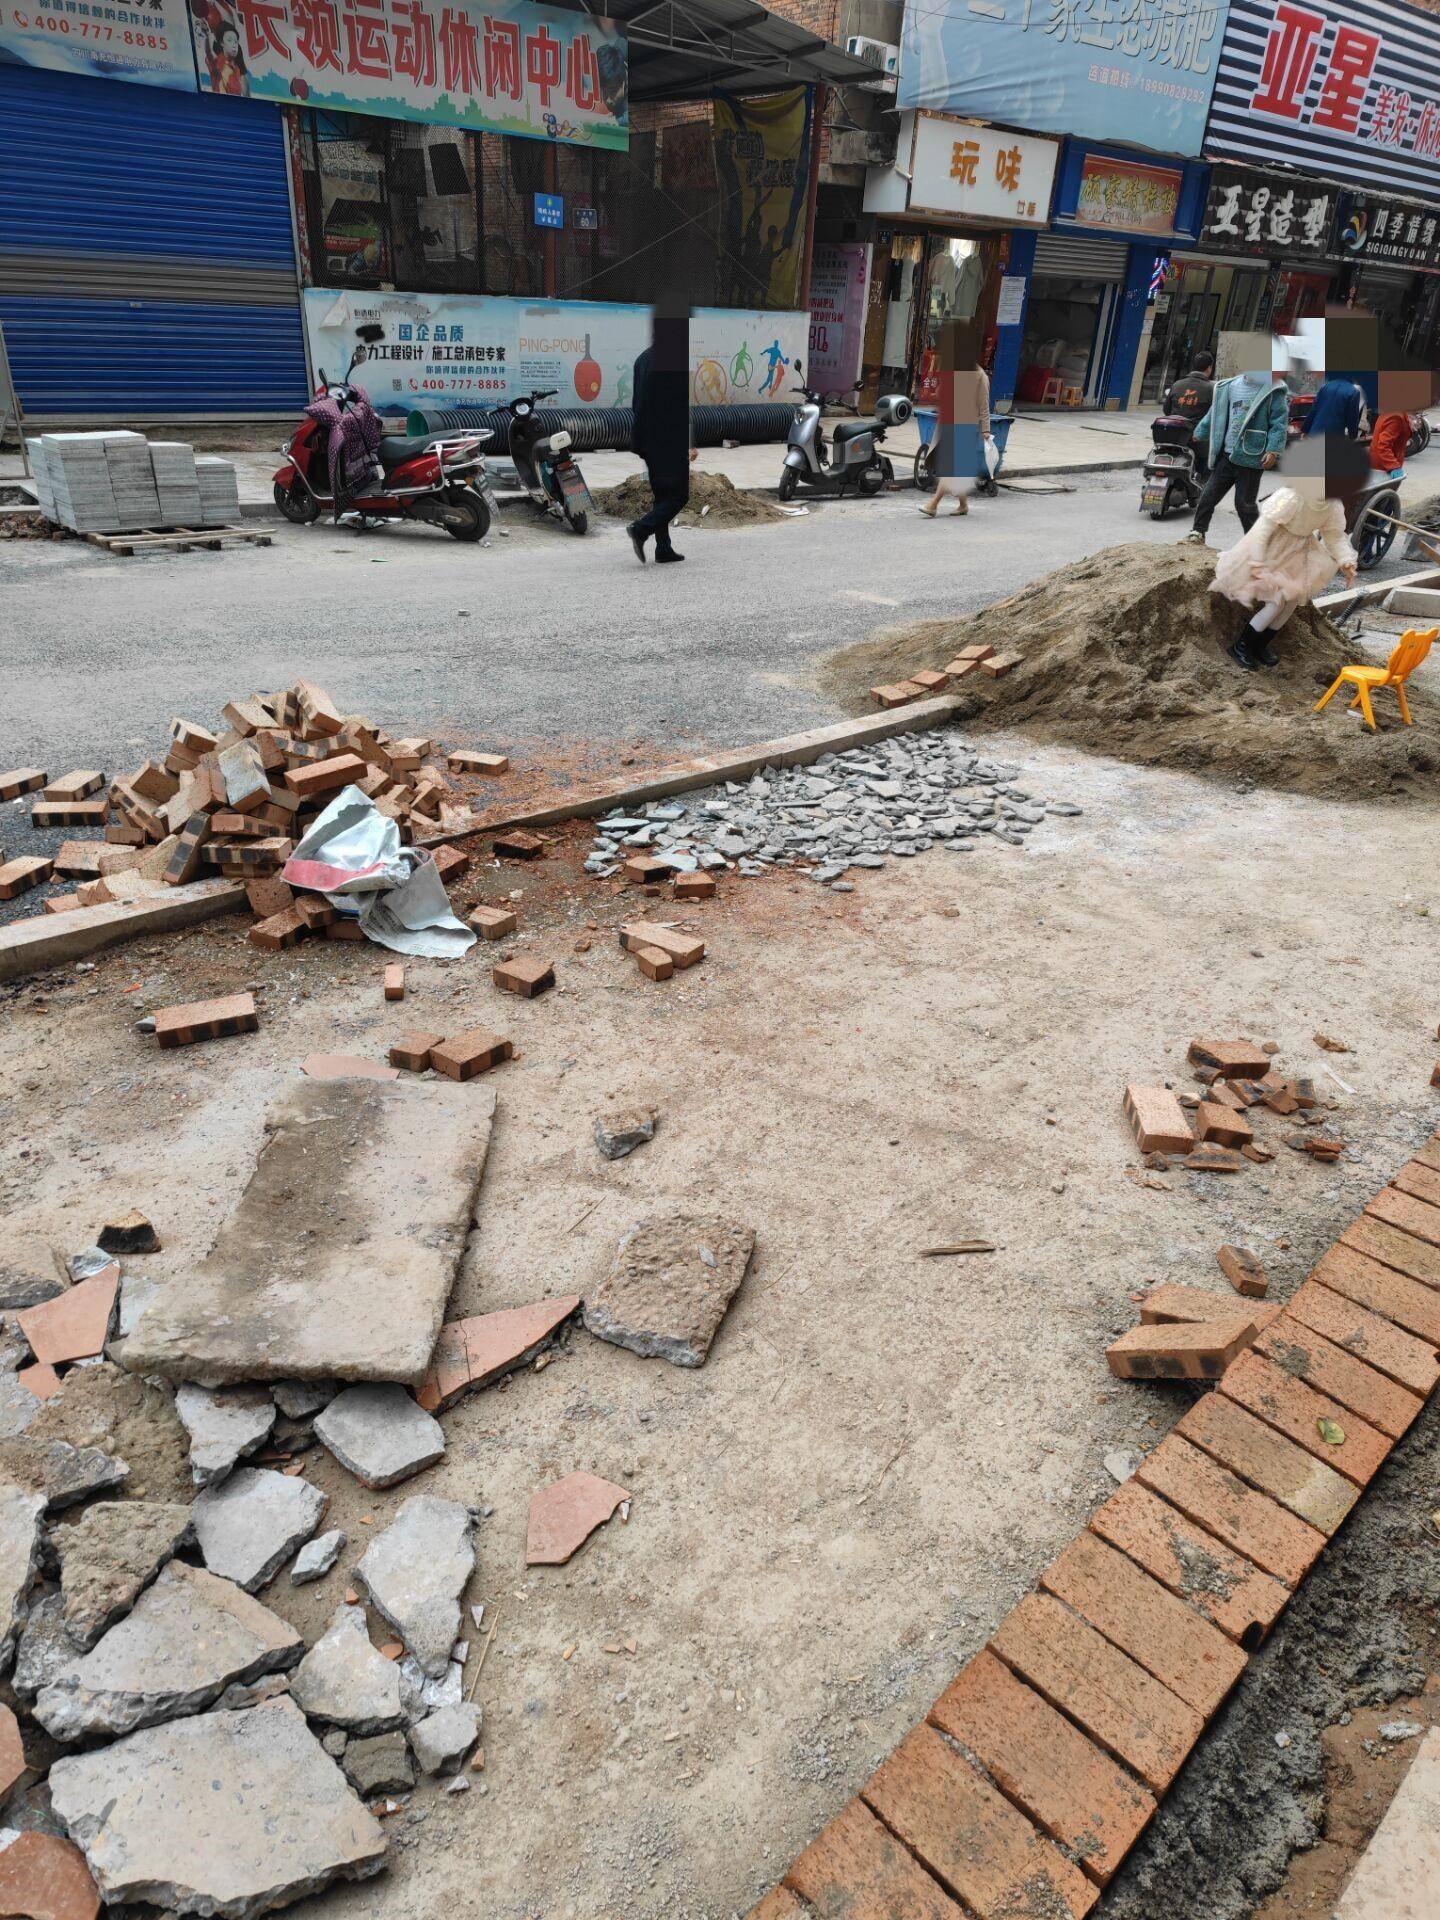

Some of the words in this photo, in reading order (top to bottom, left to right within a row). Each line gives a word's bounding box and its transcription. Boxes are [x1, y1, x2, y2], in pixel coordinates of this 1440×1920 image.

[34, 15, 169, 51] 400-777-8885
[1251, 4, 1382, 134] 亚星
[950, 140, 1023, 193] 玩味
[398, 324, 464, 342] 国企品质
[421, 378, 507, 390] 400-777-8885
